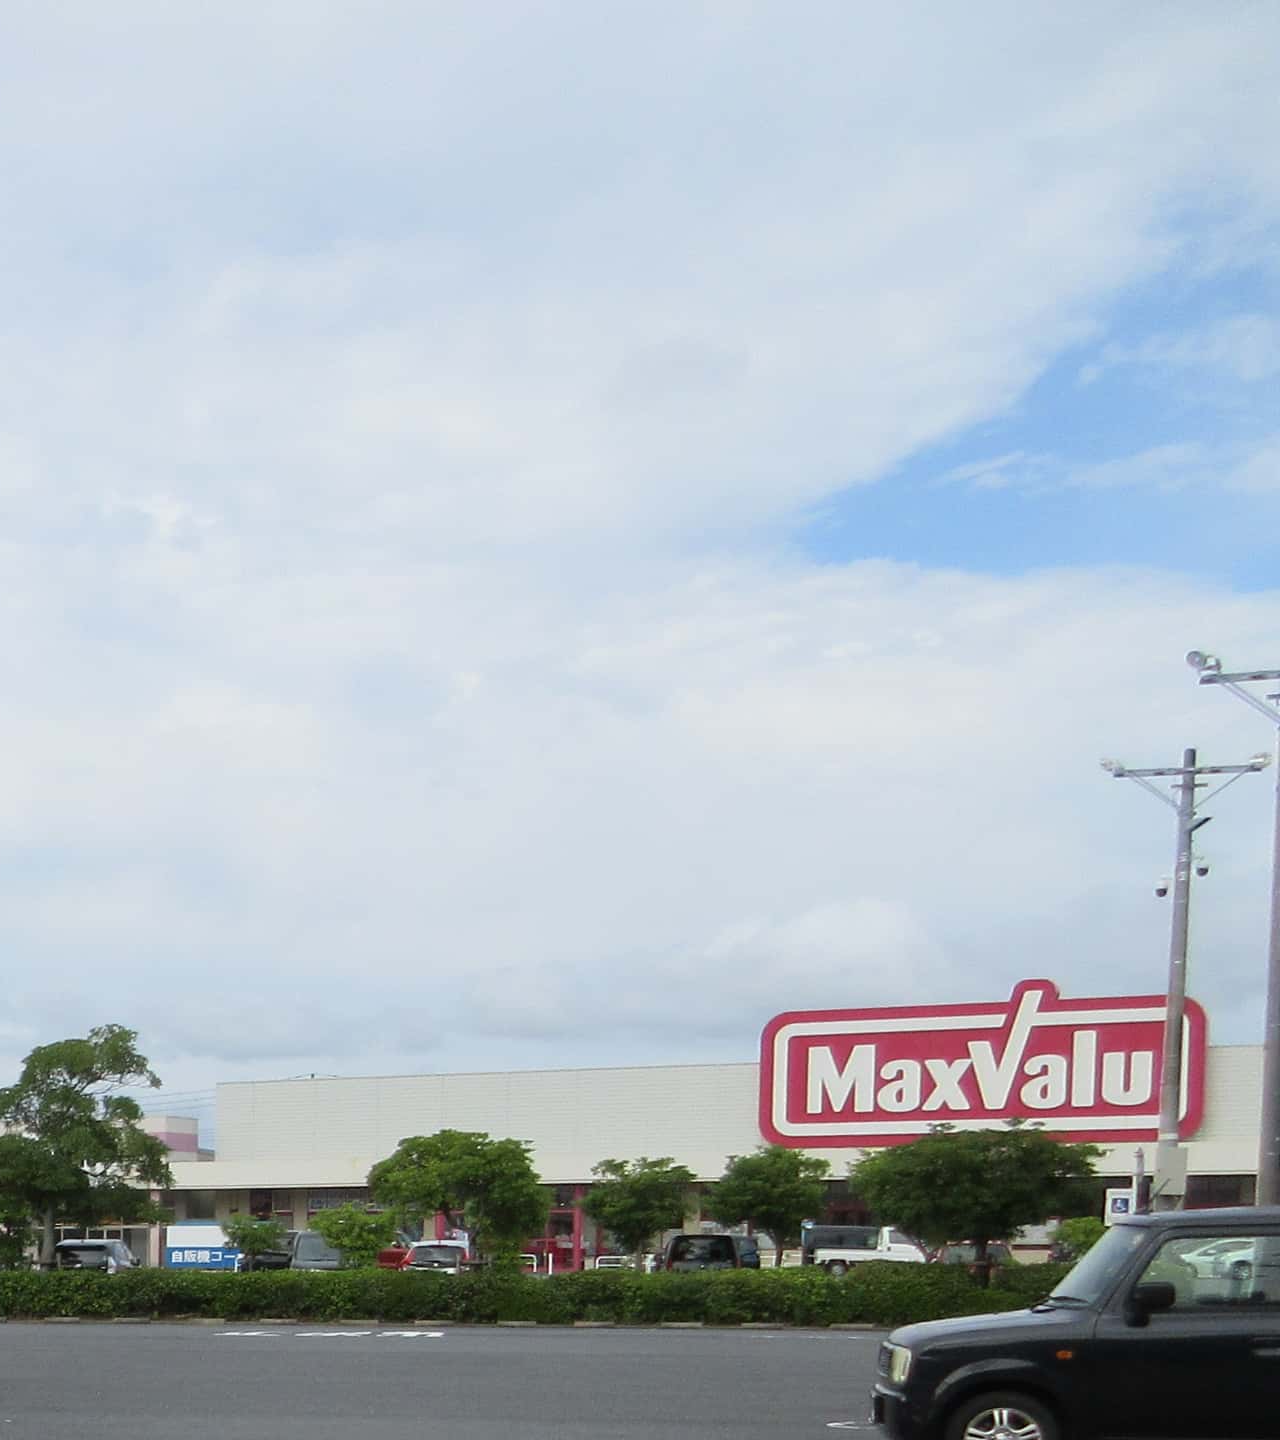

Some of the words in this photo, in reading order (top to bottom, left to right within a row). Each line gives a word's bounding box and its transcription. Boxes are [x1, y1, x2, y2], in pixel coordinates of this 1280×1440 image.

[806, 990, 1153, 1114] MaxValu
[171, 1249, 238, 1264] 自販機コー
